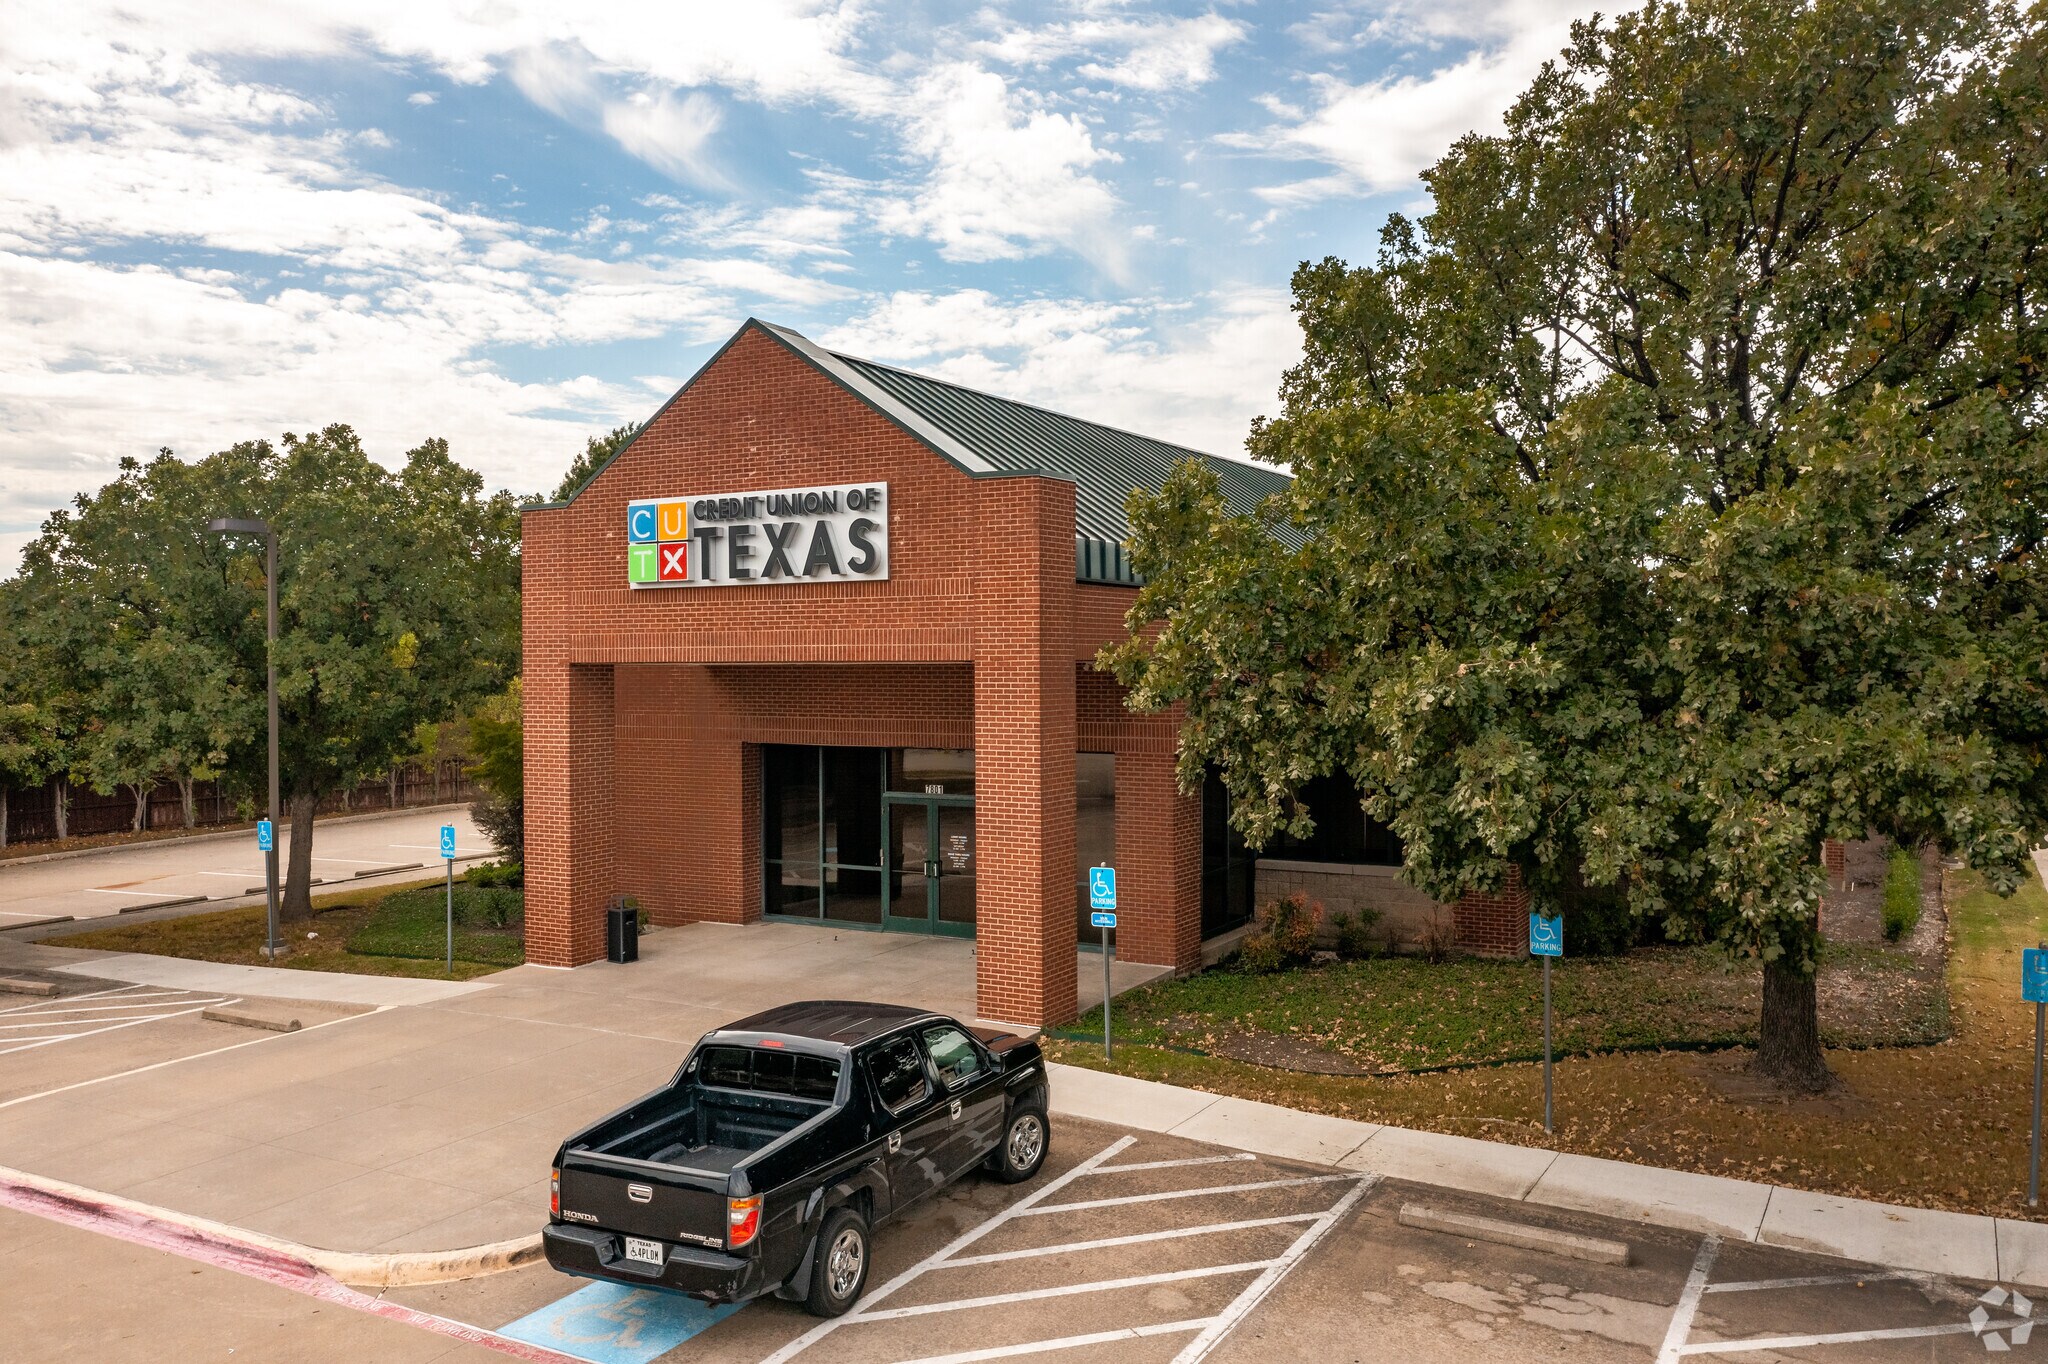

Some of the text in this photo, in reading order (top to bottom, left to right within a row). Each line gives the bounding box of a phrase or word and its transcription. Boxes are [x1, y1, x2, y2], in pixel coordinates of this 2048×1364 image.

[693, 488, 880, 522] CREDIT UNION OF
[694, 518, 881, 580] TEXAS
[925, 784, 943, 794] 7801
[1091, 897, 1115, 905] PARKING
[1531, 942, 1561, 952] PARKING
[563, 1209, 599, 1222] HONDA
